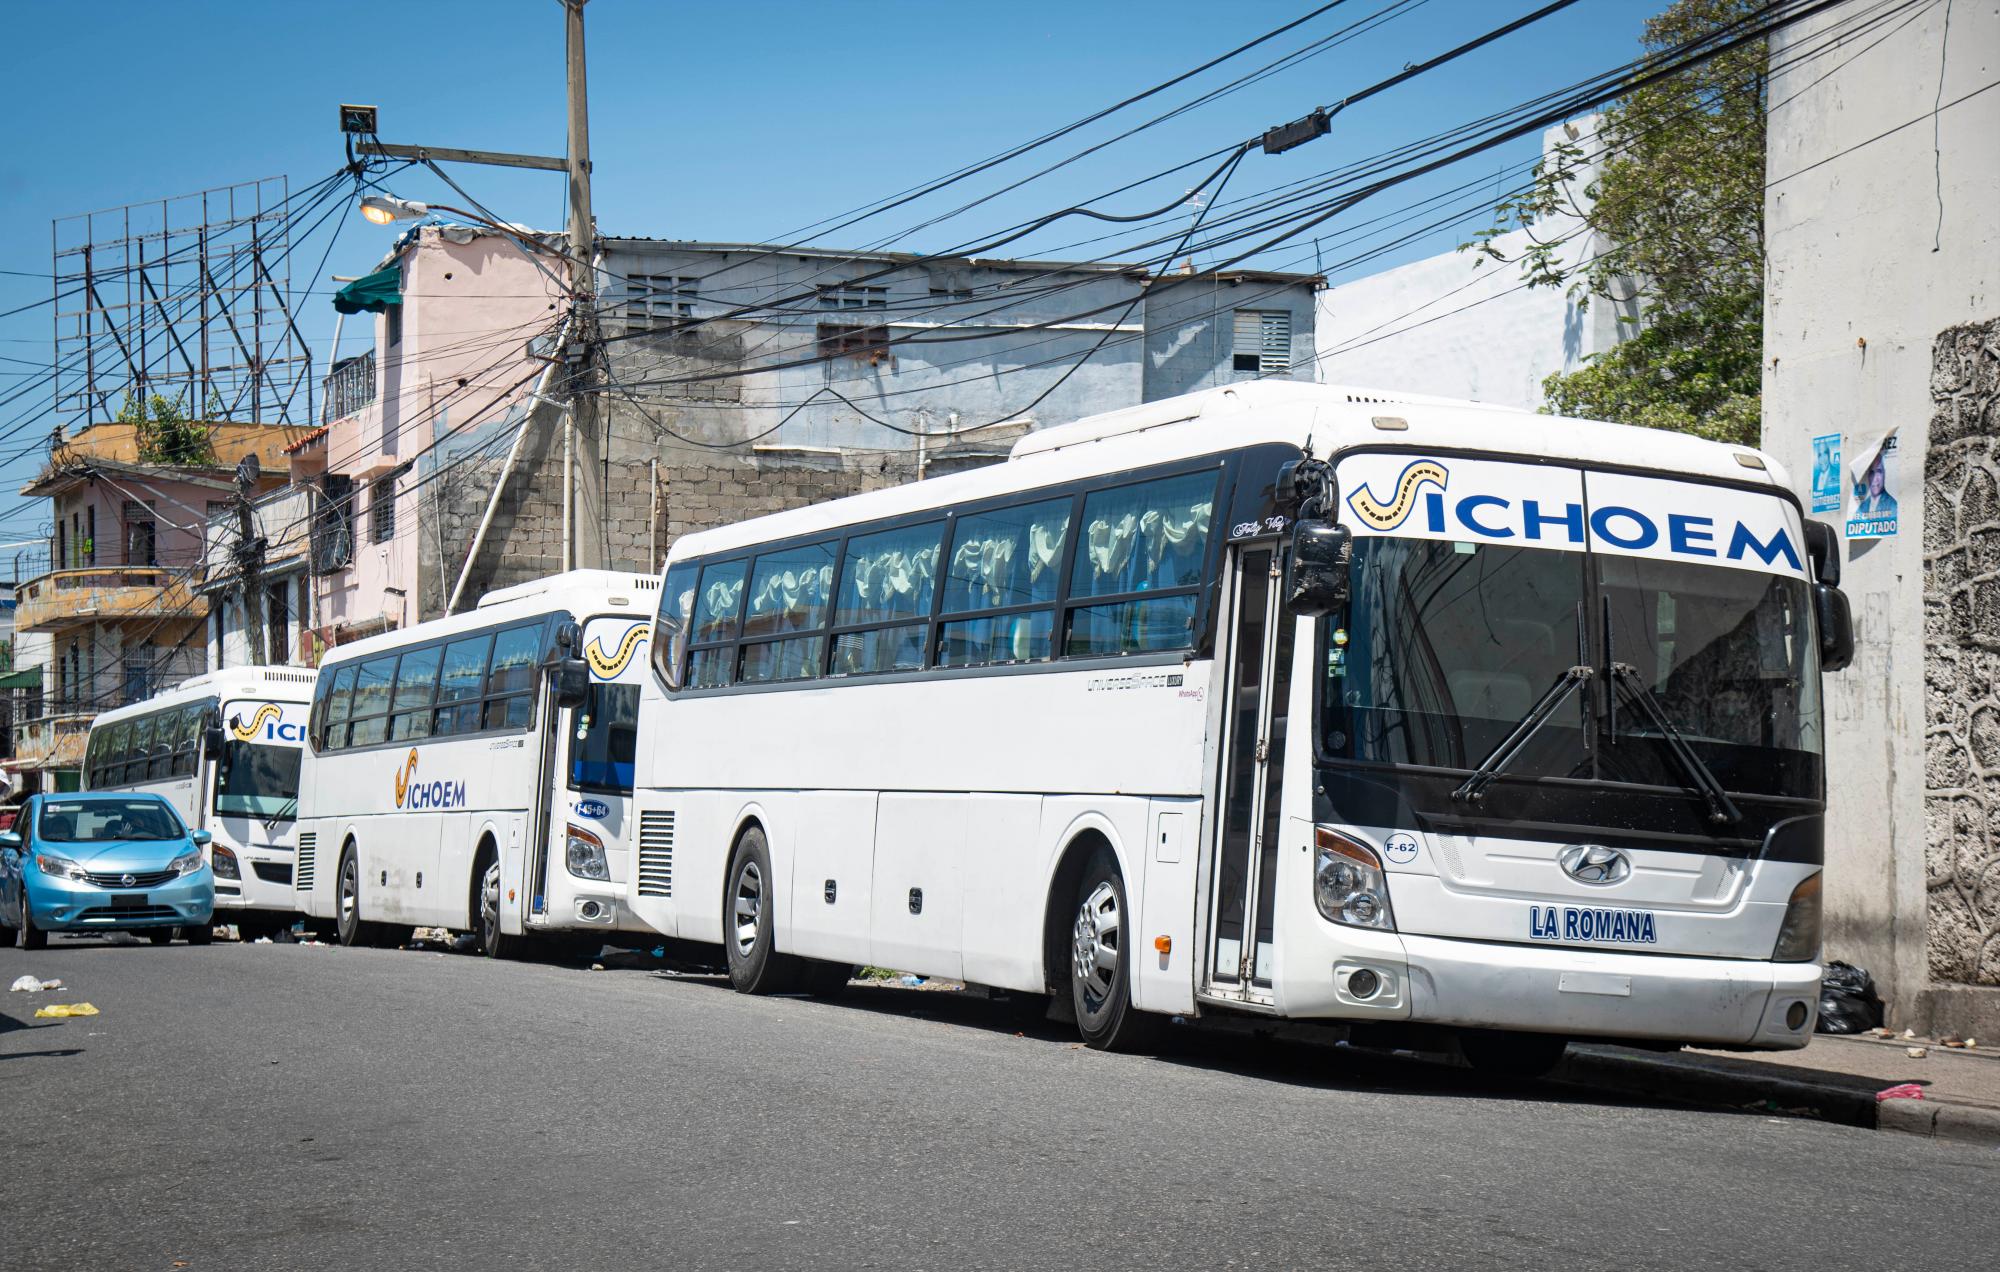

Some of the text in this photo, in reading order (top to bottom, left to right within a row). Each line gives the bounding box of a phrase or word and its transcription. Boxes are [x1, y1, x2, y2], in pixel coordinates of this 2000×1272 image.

[1848, 520, 1896, 535] DIPUTADO
[1386, 843, 1416, 852] F-62
[1530, 906, 1656, 943] LA ROMANA
